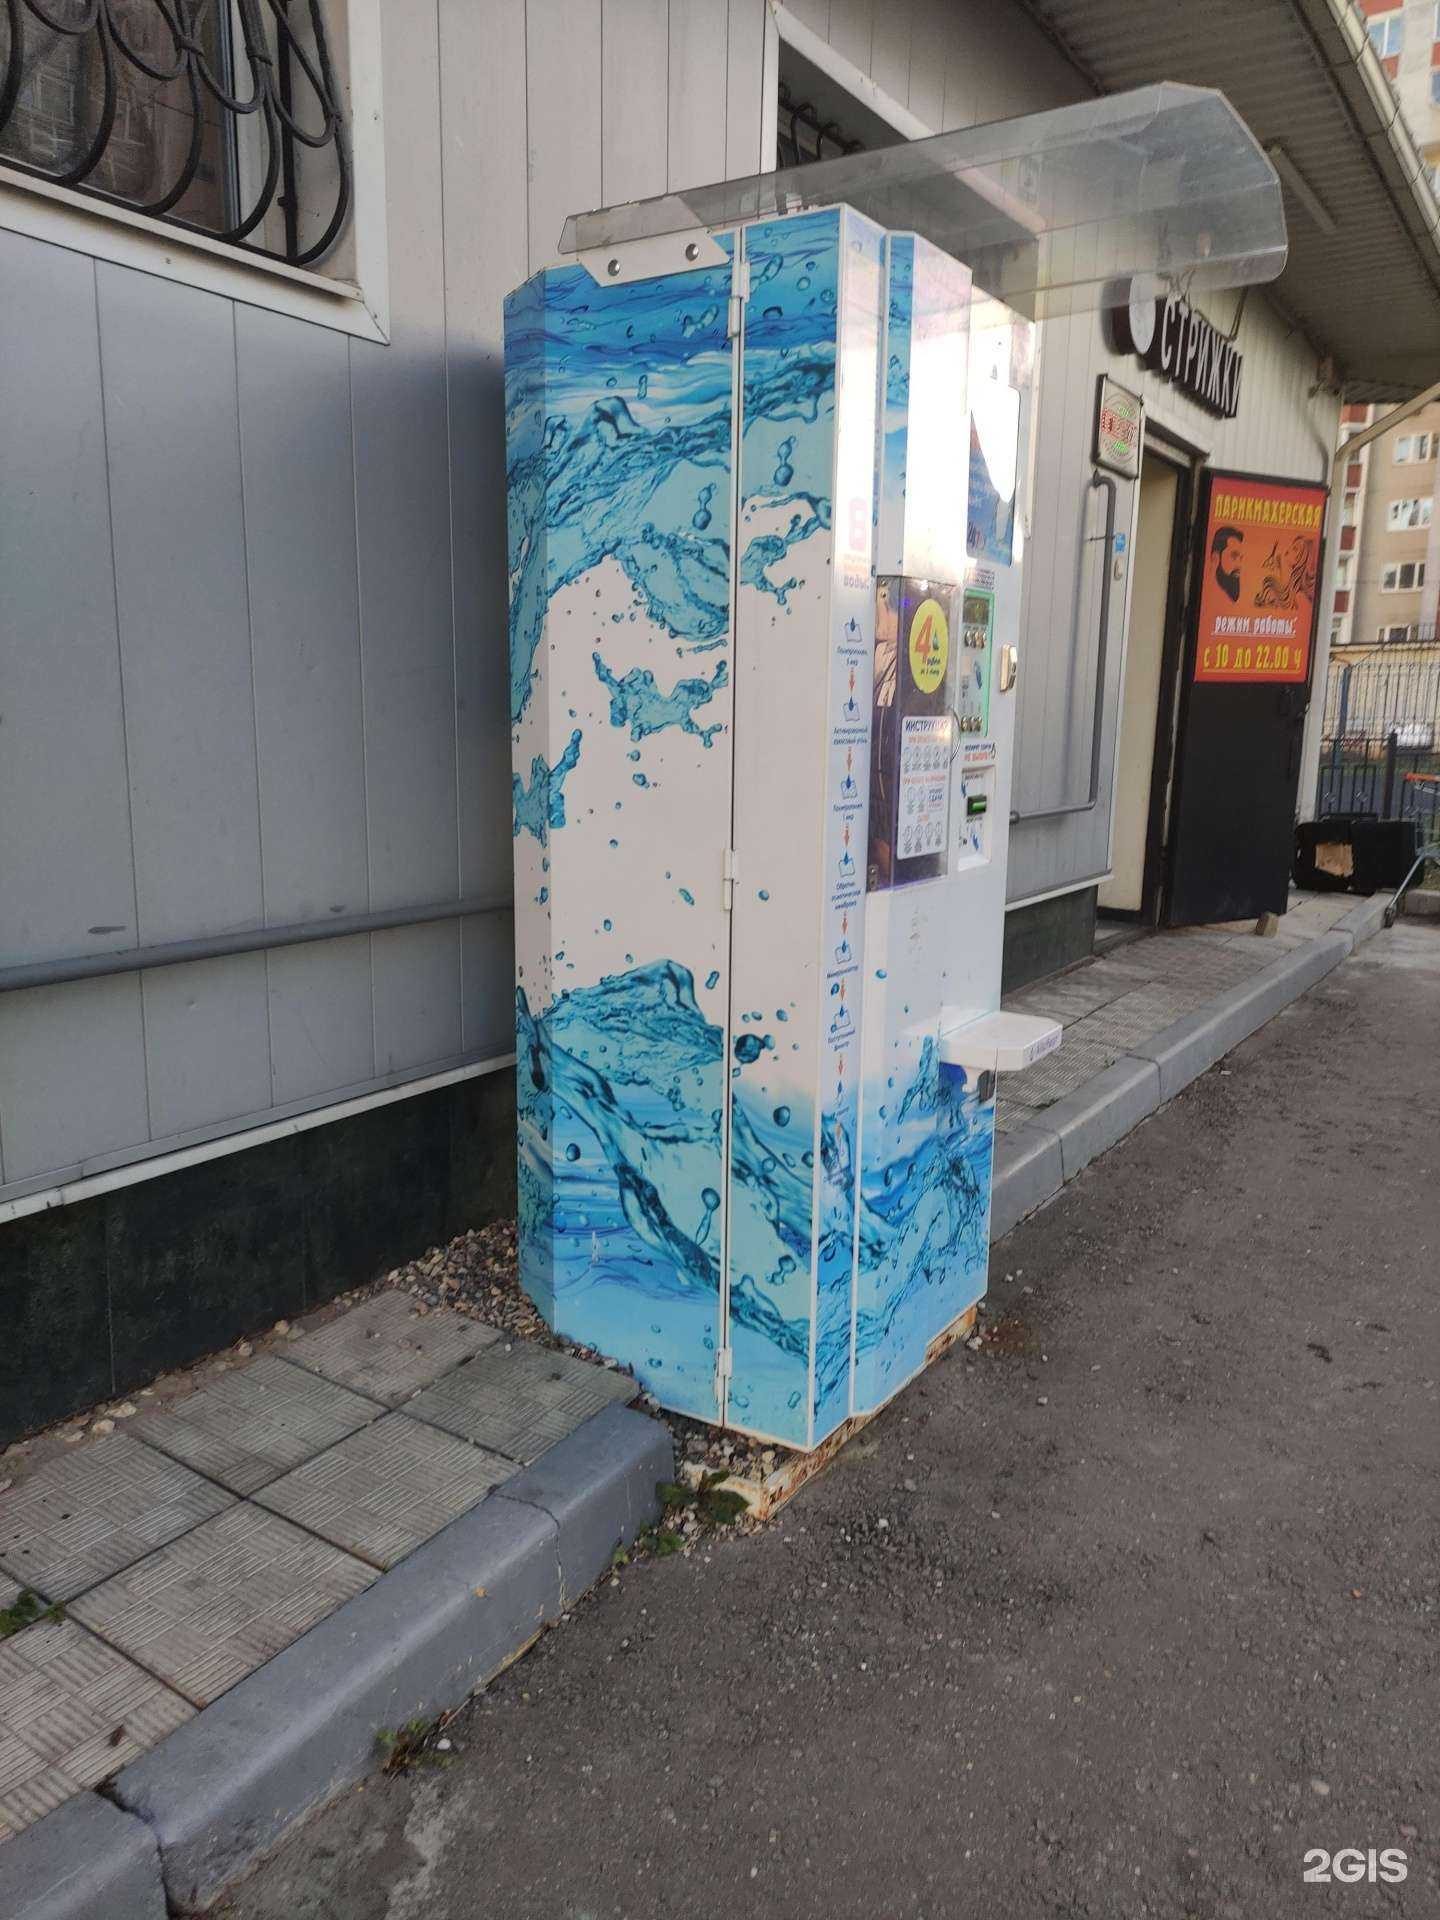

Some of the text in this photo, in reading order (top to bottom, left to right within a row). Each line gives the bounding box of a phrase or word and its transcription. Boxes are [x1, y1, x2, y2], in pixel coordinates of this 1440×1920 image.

[1161, 293, 1243, 416] СТРИЖКИ
[1214, 494, 1323, 529] ПАРИКМАХЕРСКАЯ
[914, 614, 933, 658] 4
[1214, 614, 1297, 635] режим работы:
[1214, 643, 1229, 667] 10
[1233, 646, 1252, 668] до
[1256, 644, 1289, 669] 22.00
